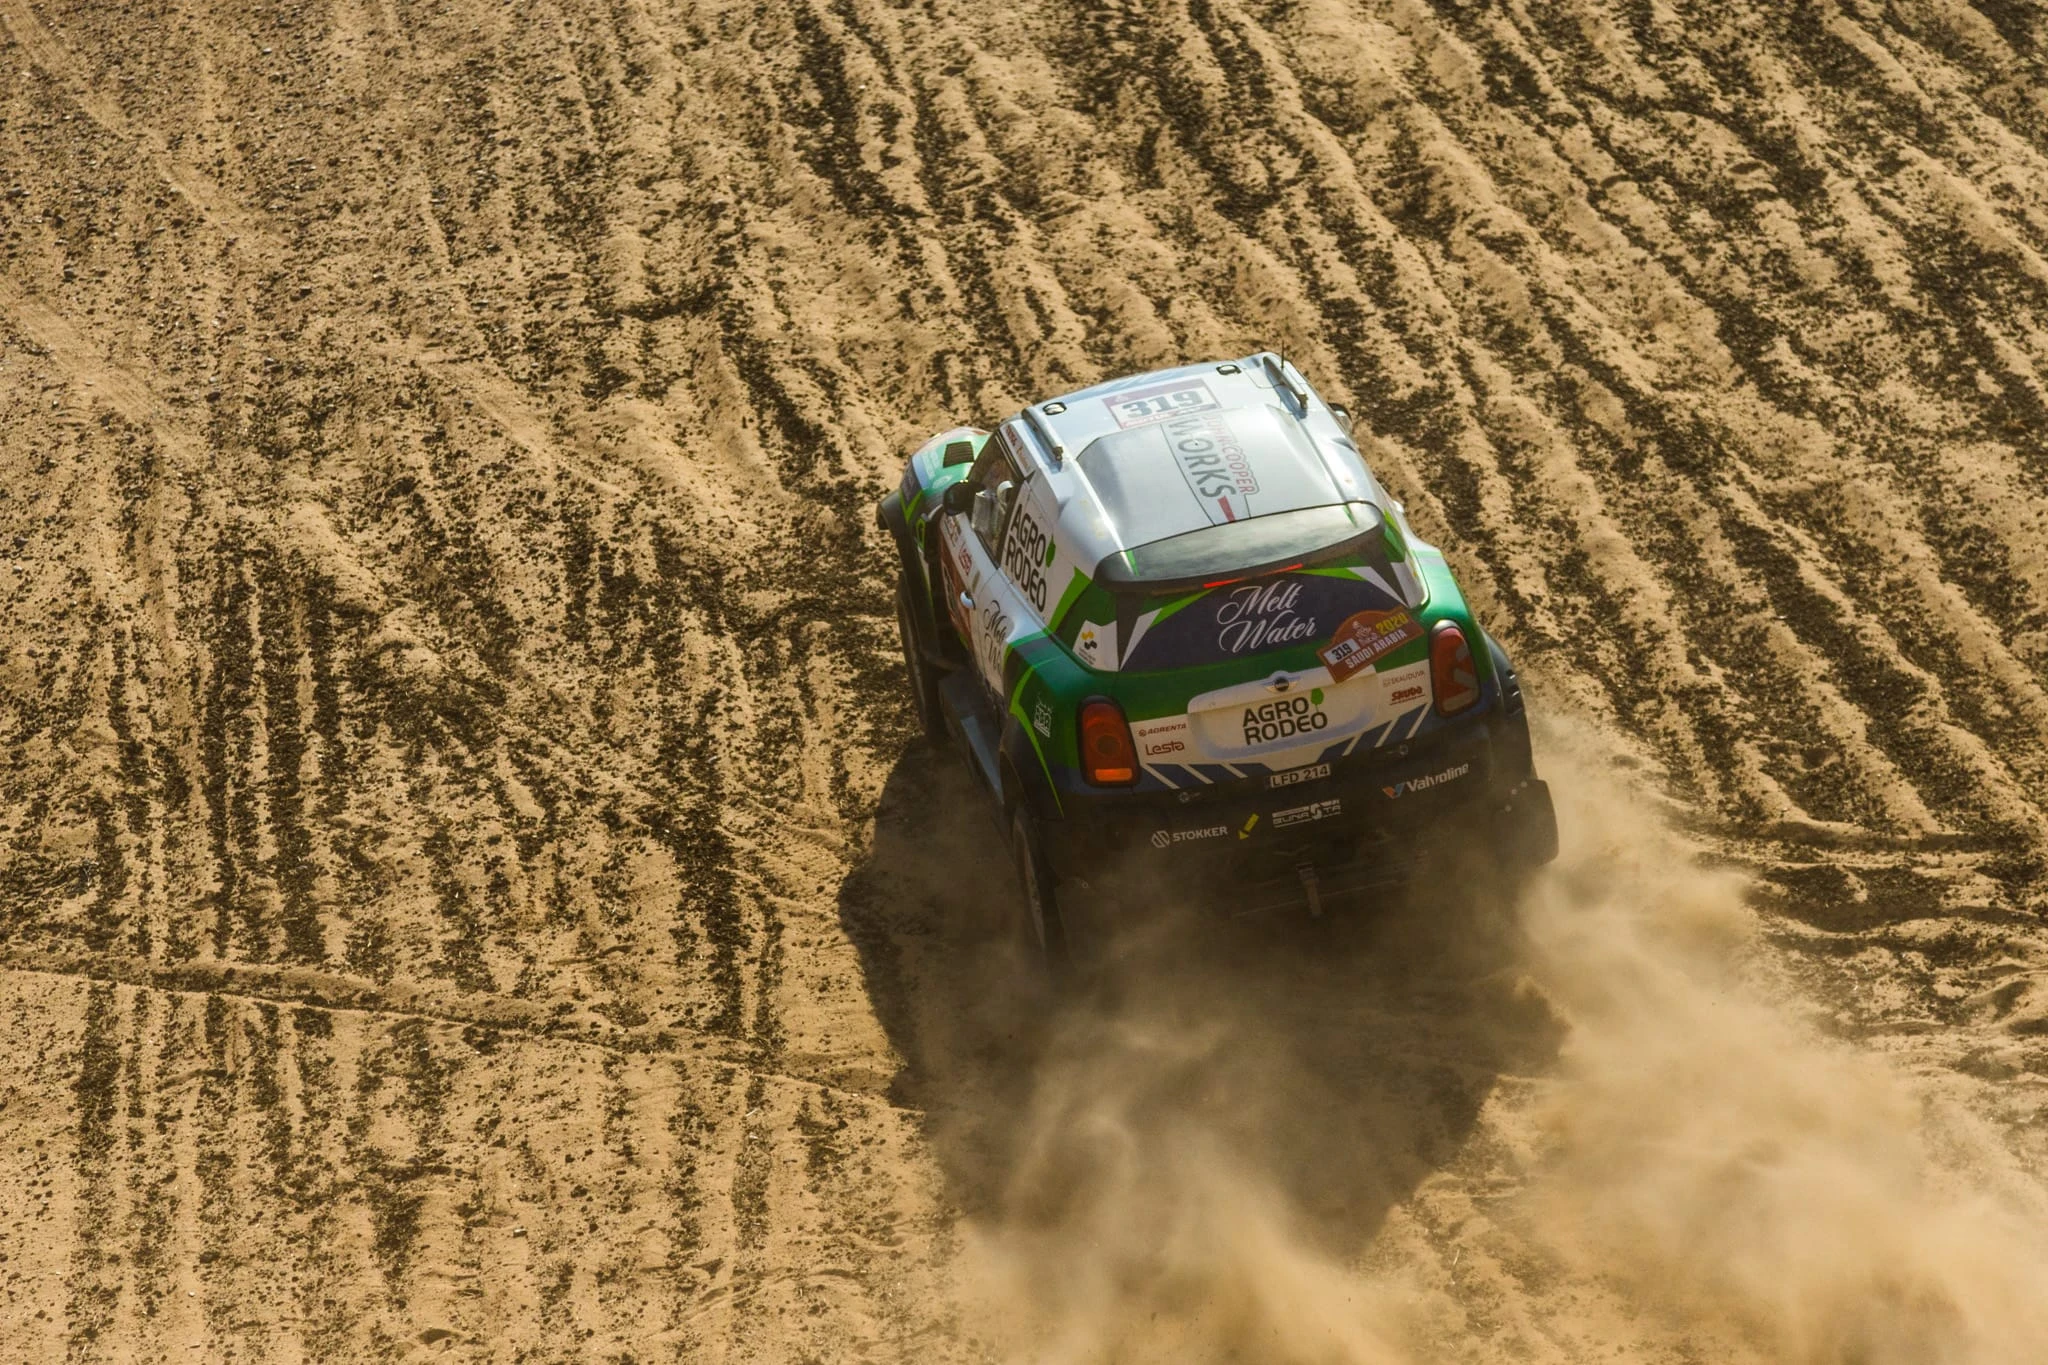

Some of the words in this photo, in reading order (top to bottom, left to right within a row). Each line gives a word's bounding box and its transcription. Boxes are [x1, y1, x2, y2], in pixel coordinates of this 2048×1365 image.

[1122, 391, 1203, 417] 319
[1168, 418, 1236, 498] WORKS
[1222, 446, 1255, 494] COOPER
[1011, 503, 1046, 568] AGRO
[1005, 534, 1047, 612] RODEO
[1217, 580, 1304, 625] Melt
[1219, 609, 1316, 653] Water
[1376, 612, 1409, 634] 2020
[1331, 642, 1352, 660] 319
[1345, 644, 1375, 669] SAUDI
[1374, 629, 1408, 652] ARABIA
[1243, 697, 1309, 727] AGRO
[1244, 712, 1328, 745] RODEO
[1145, 741, 1185, 756] Lesta
[1272, 772, 1299, 787] LFD
[1303, 766, 1328, 781] 214
[1407, 763, 1469, 792] Valvoline
[1173, 826, 1228, 842] STOKKER
